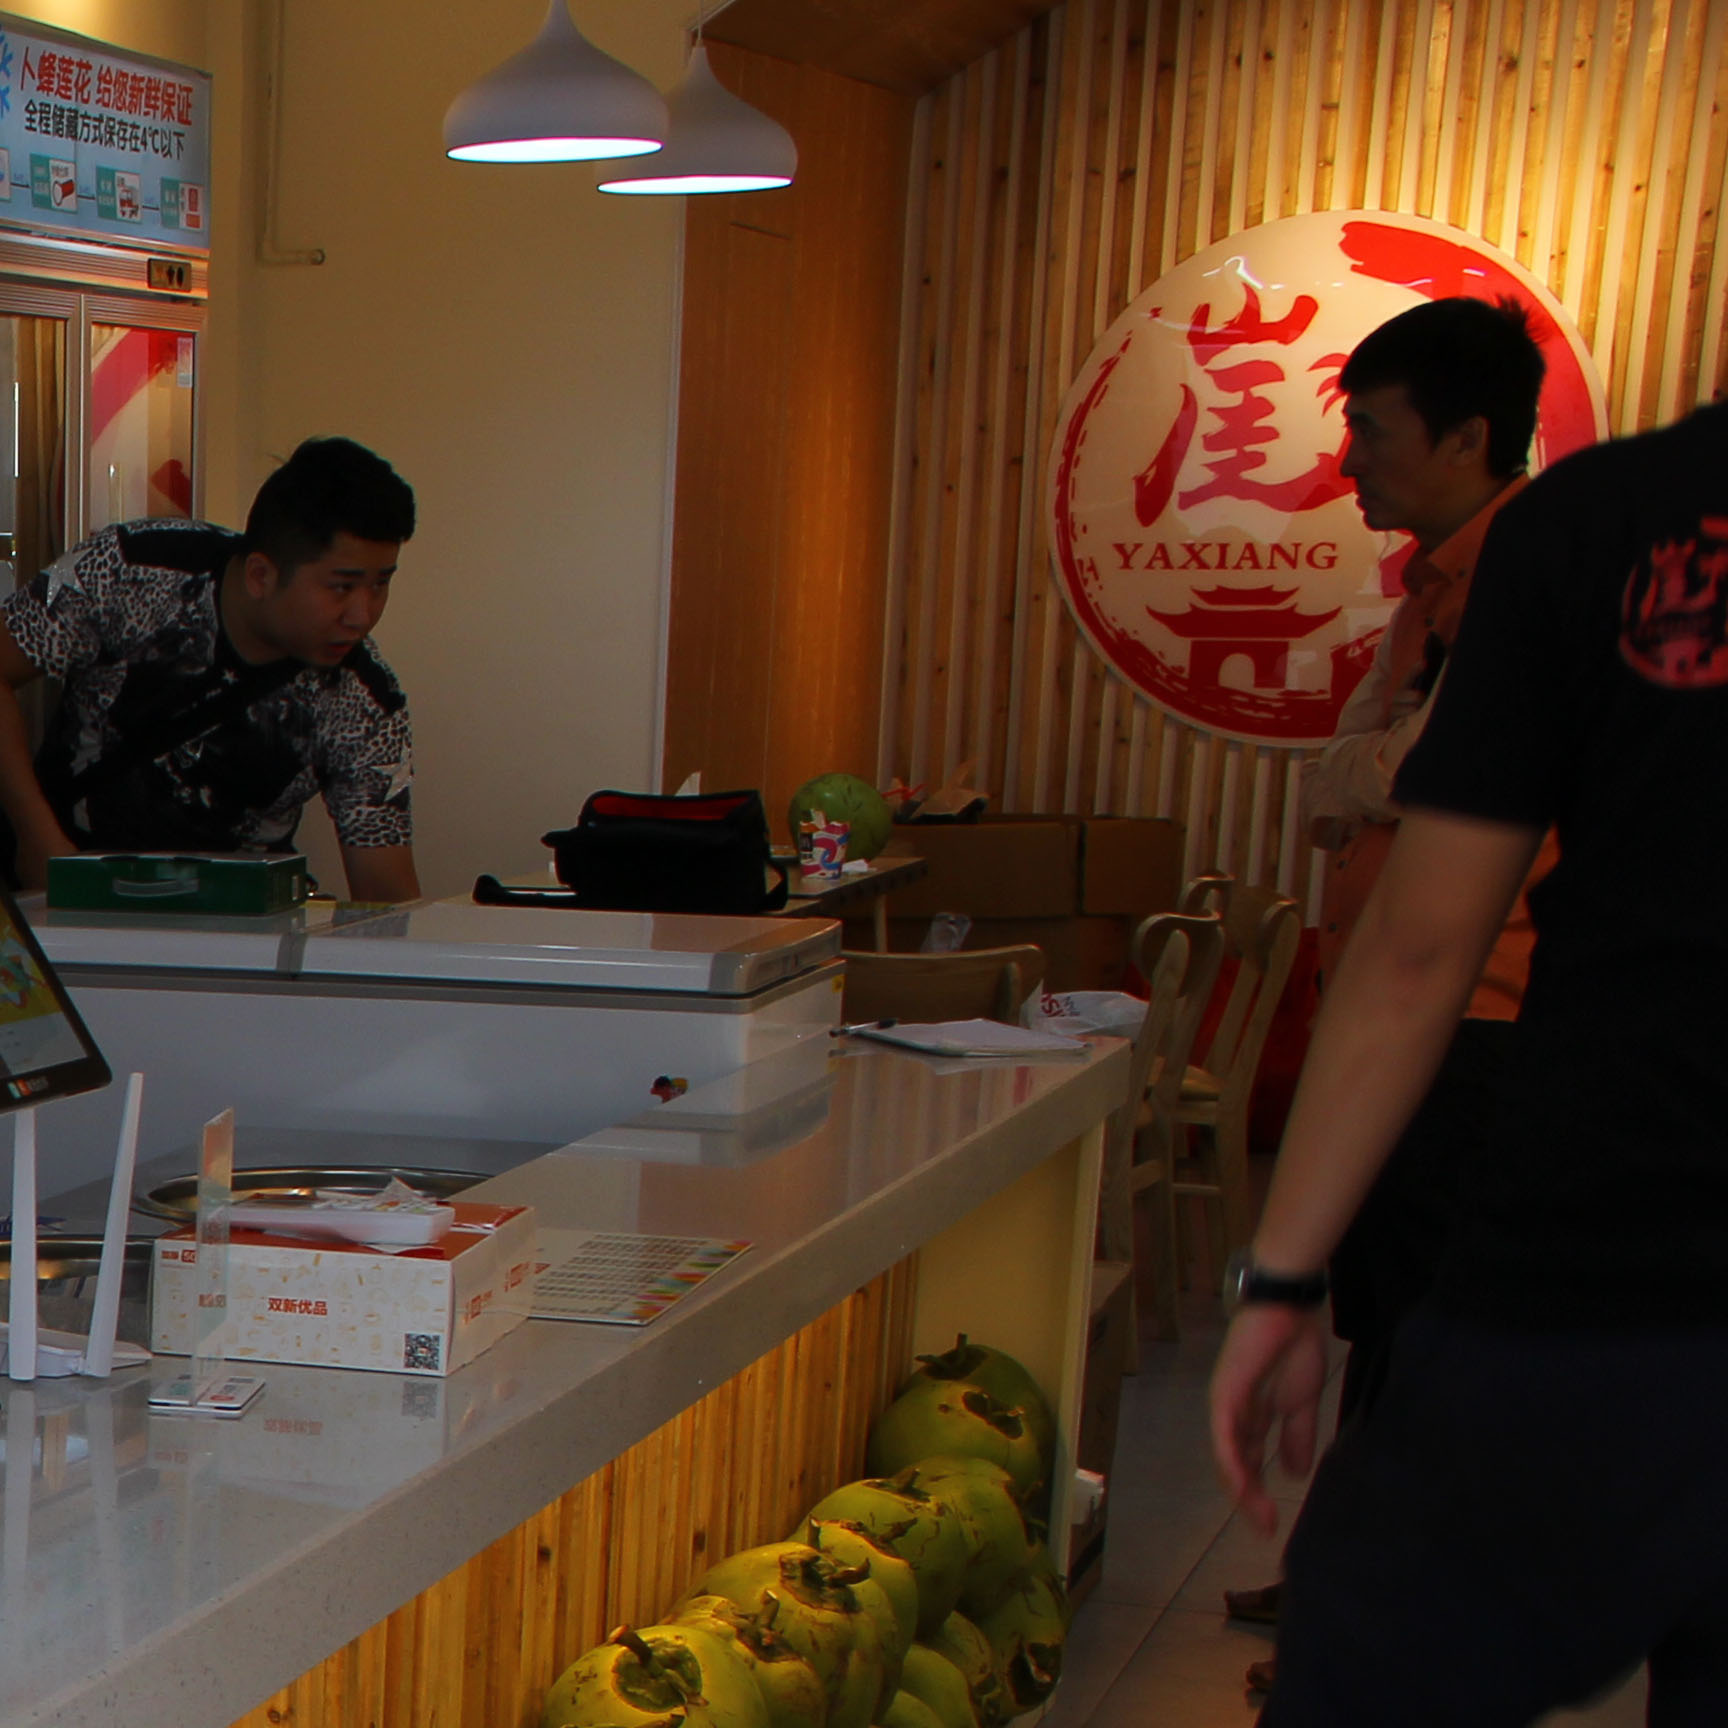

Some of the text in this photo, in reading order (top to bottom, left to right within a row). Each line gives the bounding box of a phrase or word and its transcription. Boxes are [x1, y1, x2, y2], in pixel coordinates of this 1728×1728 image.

[19, 46, 194, 126] 卜蜂莲花 给您新鲜保证
[1112, 540, 1340, 572] YAXIANG
[266, 1297, 330, 1317] 双新优品
